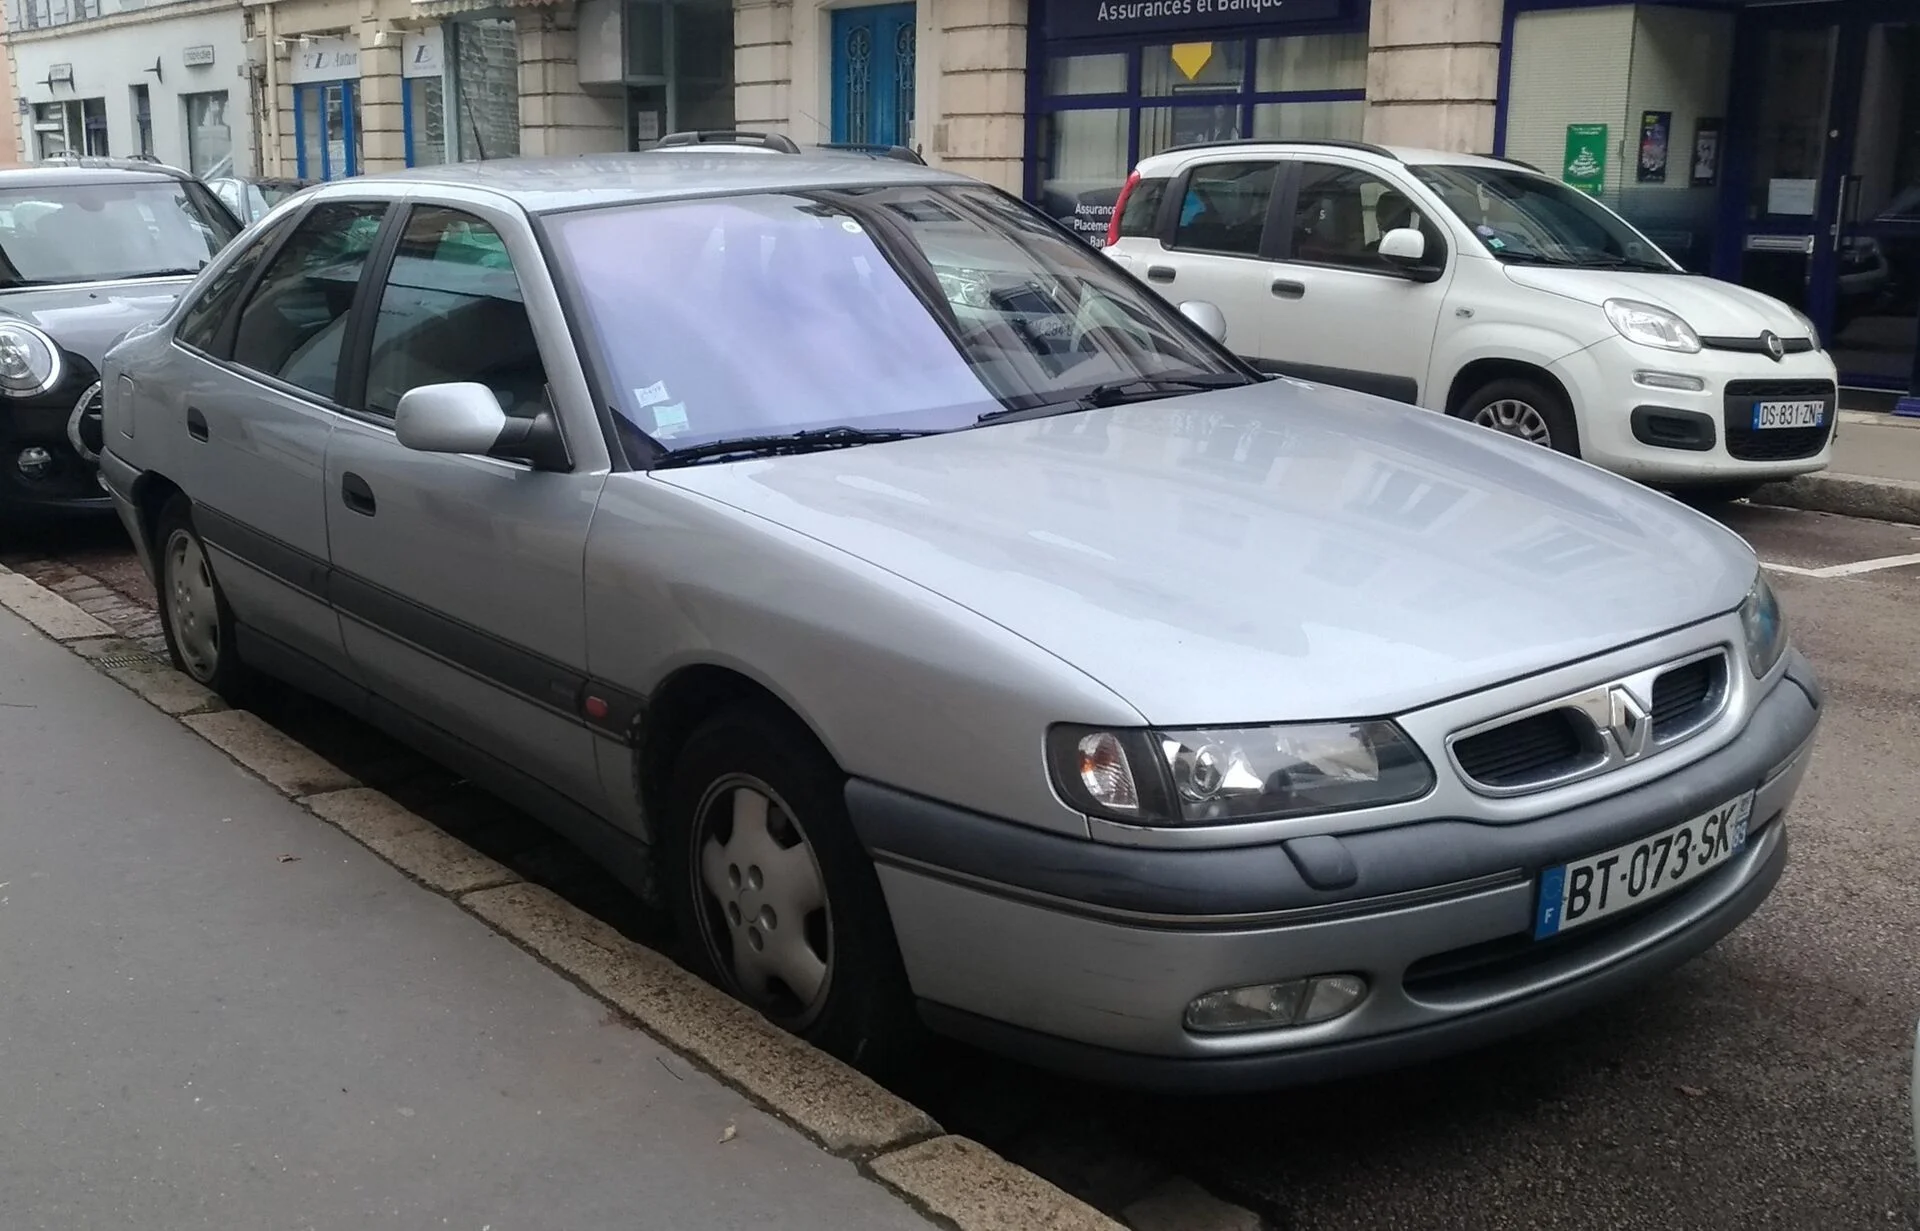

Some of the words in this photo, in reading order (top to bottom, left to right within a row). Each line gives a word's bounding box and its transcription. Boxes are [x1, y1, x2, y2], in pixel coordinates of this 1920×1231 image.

[1098, 0, 1192, 20] Assurances
[1090, 235, 1106, 248] Ban
[1761, 404, 1816, 426] DS-831-ZN
[1566, 803, 1737, 921] BT-073-SK
[1544, 907, 1554, 924] F
